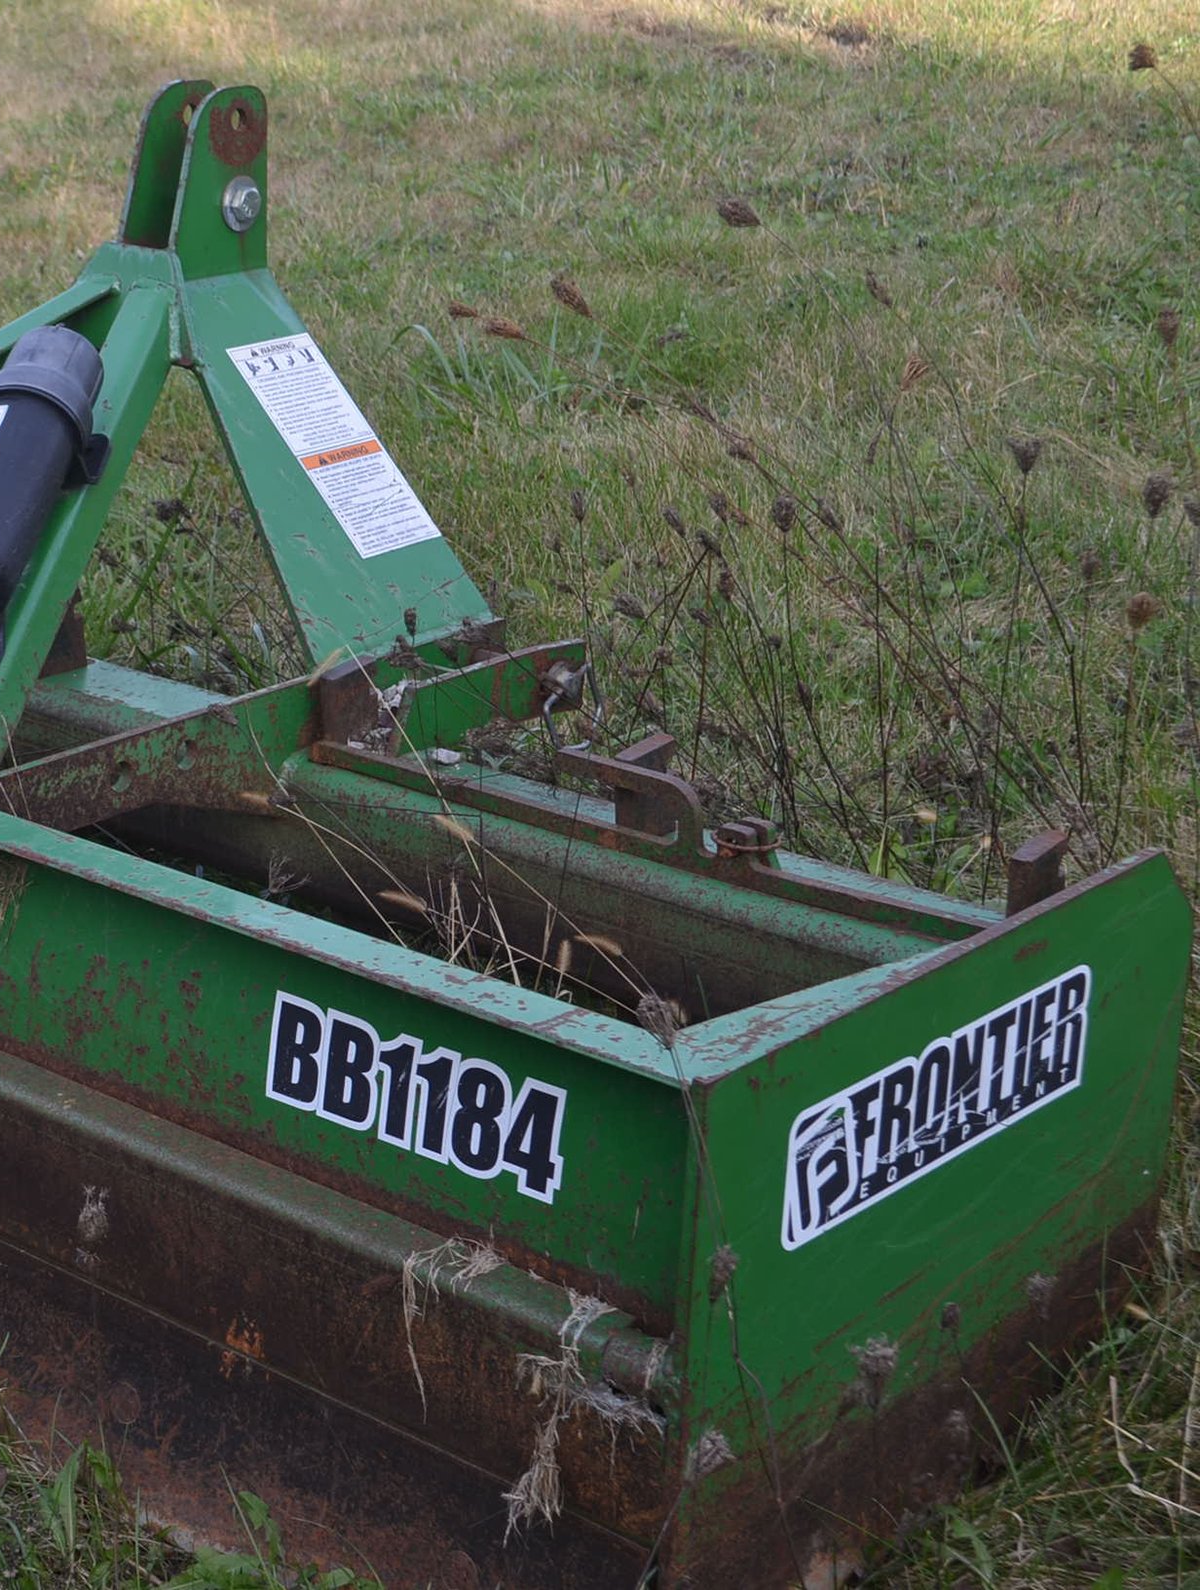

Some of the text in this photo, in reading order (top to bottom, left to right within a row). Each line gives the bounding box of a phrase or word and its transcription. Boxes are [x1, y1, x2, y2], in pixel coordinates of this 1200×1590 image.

[260, 342, 295, 356] WARNING
[327, 446, 368, 463] WARNING
[268, 994, 564, 1202] BB1184
[846, 970, 1089, 1180] FRONTIER
[859, 1067, 1069, 1200] EQUIPMENT
